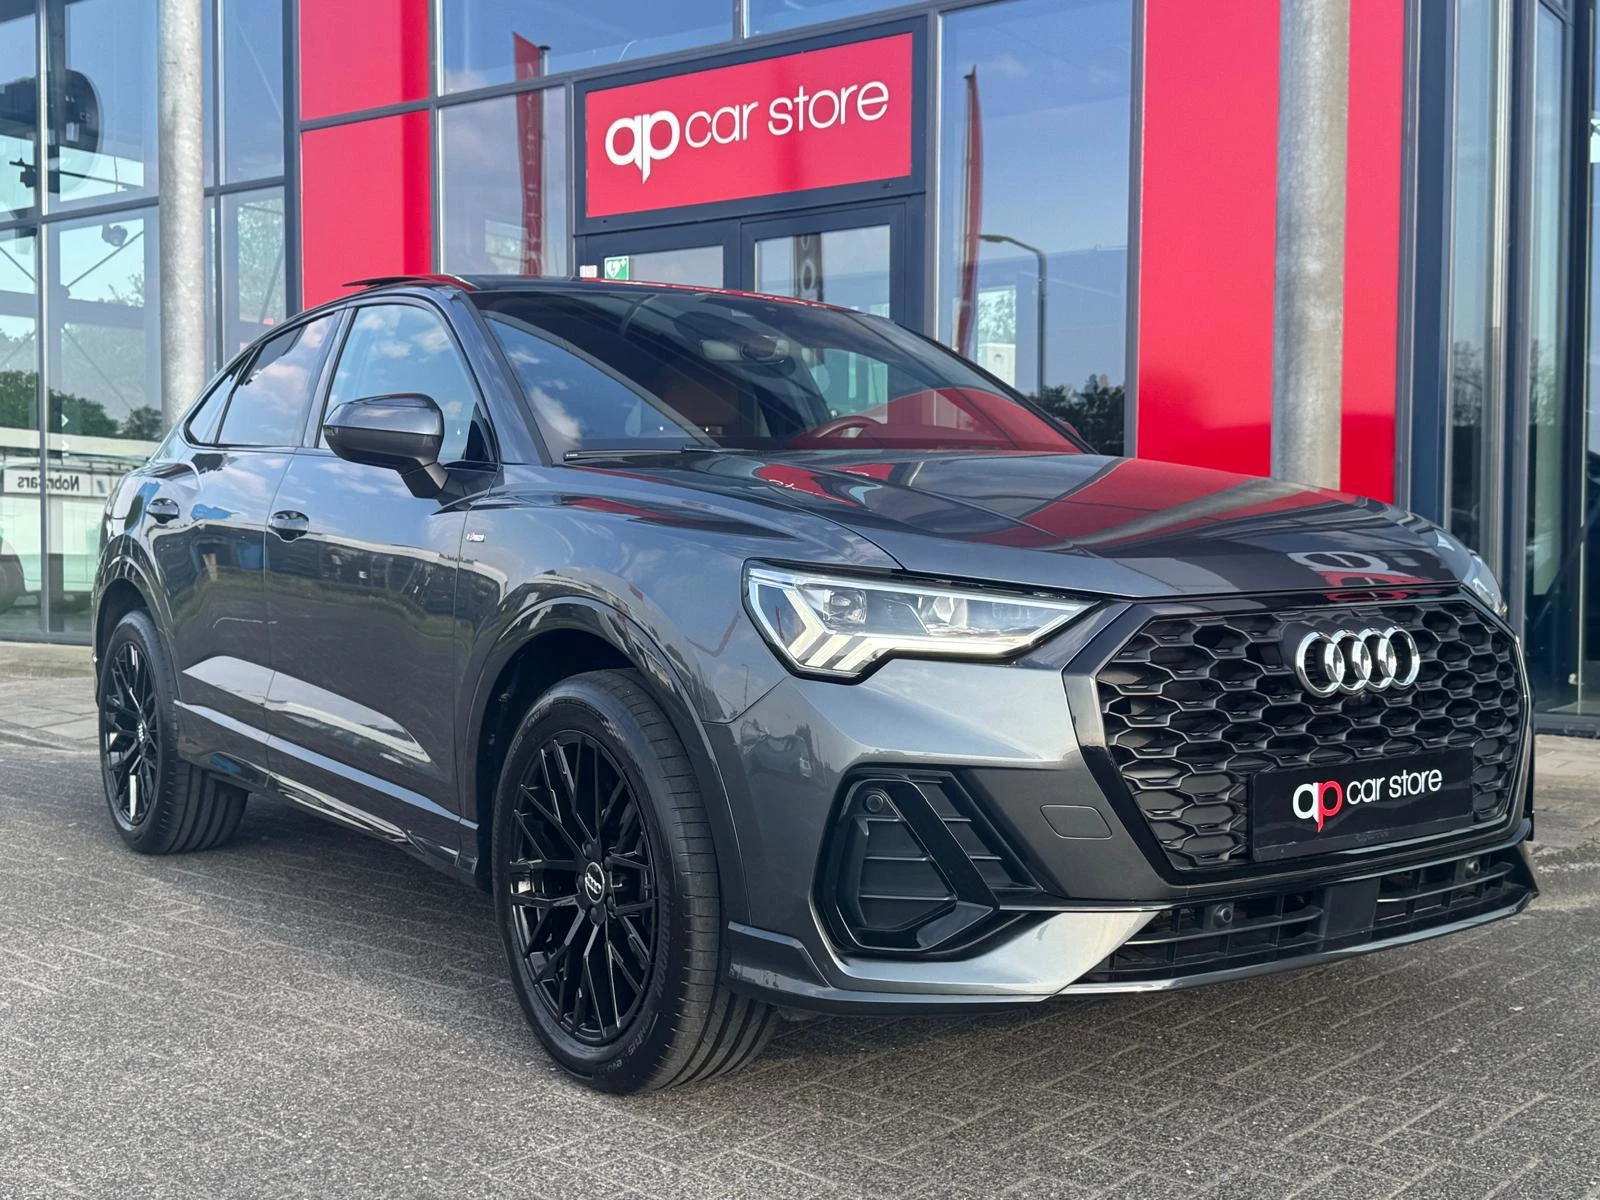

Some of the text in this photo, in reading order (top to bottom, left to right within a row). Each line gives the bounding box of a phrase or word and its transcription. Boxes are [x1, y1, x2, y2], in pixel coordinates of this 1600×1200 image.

[685, 101, 759, 148] car
[768, 80, 889, 136] store
[1346, 776, 1385, 805] car
[1389, 769, 1443, 798] store
